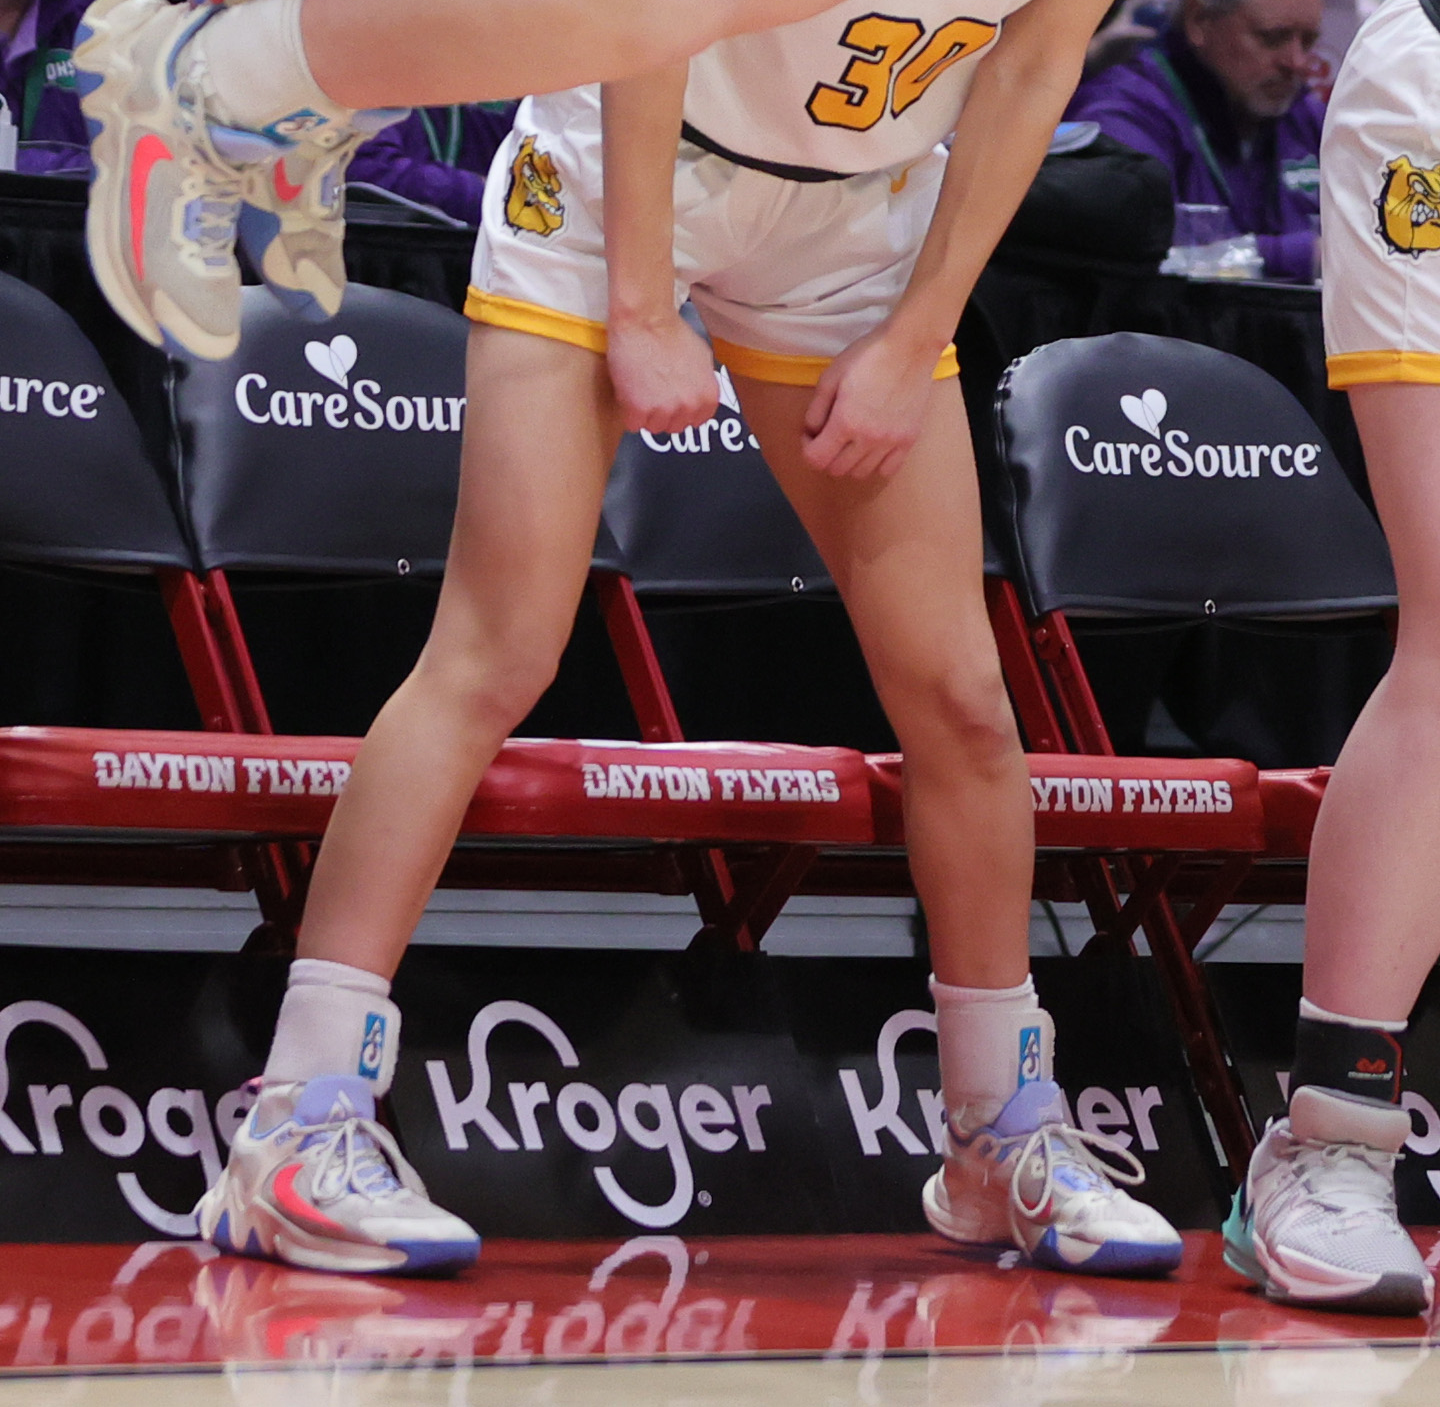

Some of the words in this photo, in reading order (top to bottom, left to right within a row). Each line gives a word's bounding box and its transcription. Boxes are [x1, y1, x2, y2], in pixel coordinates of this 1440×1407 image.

[805, 12, 1000, 133] 30
[1064, 425, 1319, 478] CareSource
[92, 751, 236, 793] DAYTON
[582, 763, 711, 801] DAYTON
[714, 769, 840, 803] FLYERS
[1119, 779, 1233, 813] FLYERS
[839, 1009, 1163, 1156] Krer
[426, 1000, 773, 1228] Kroger
